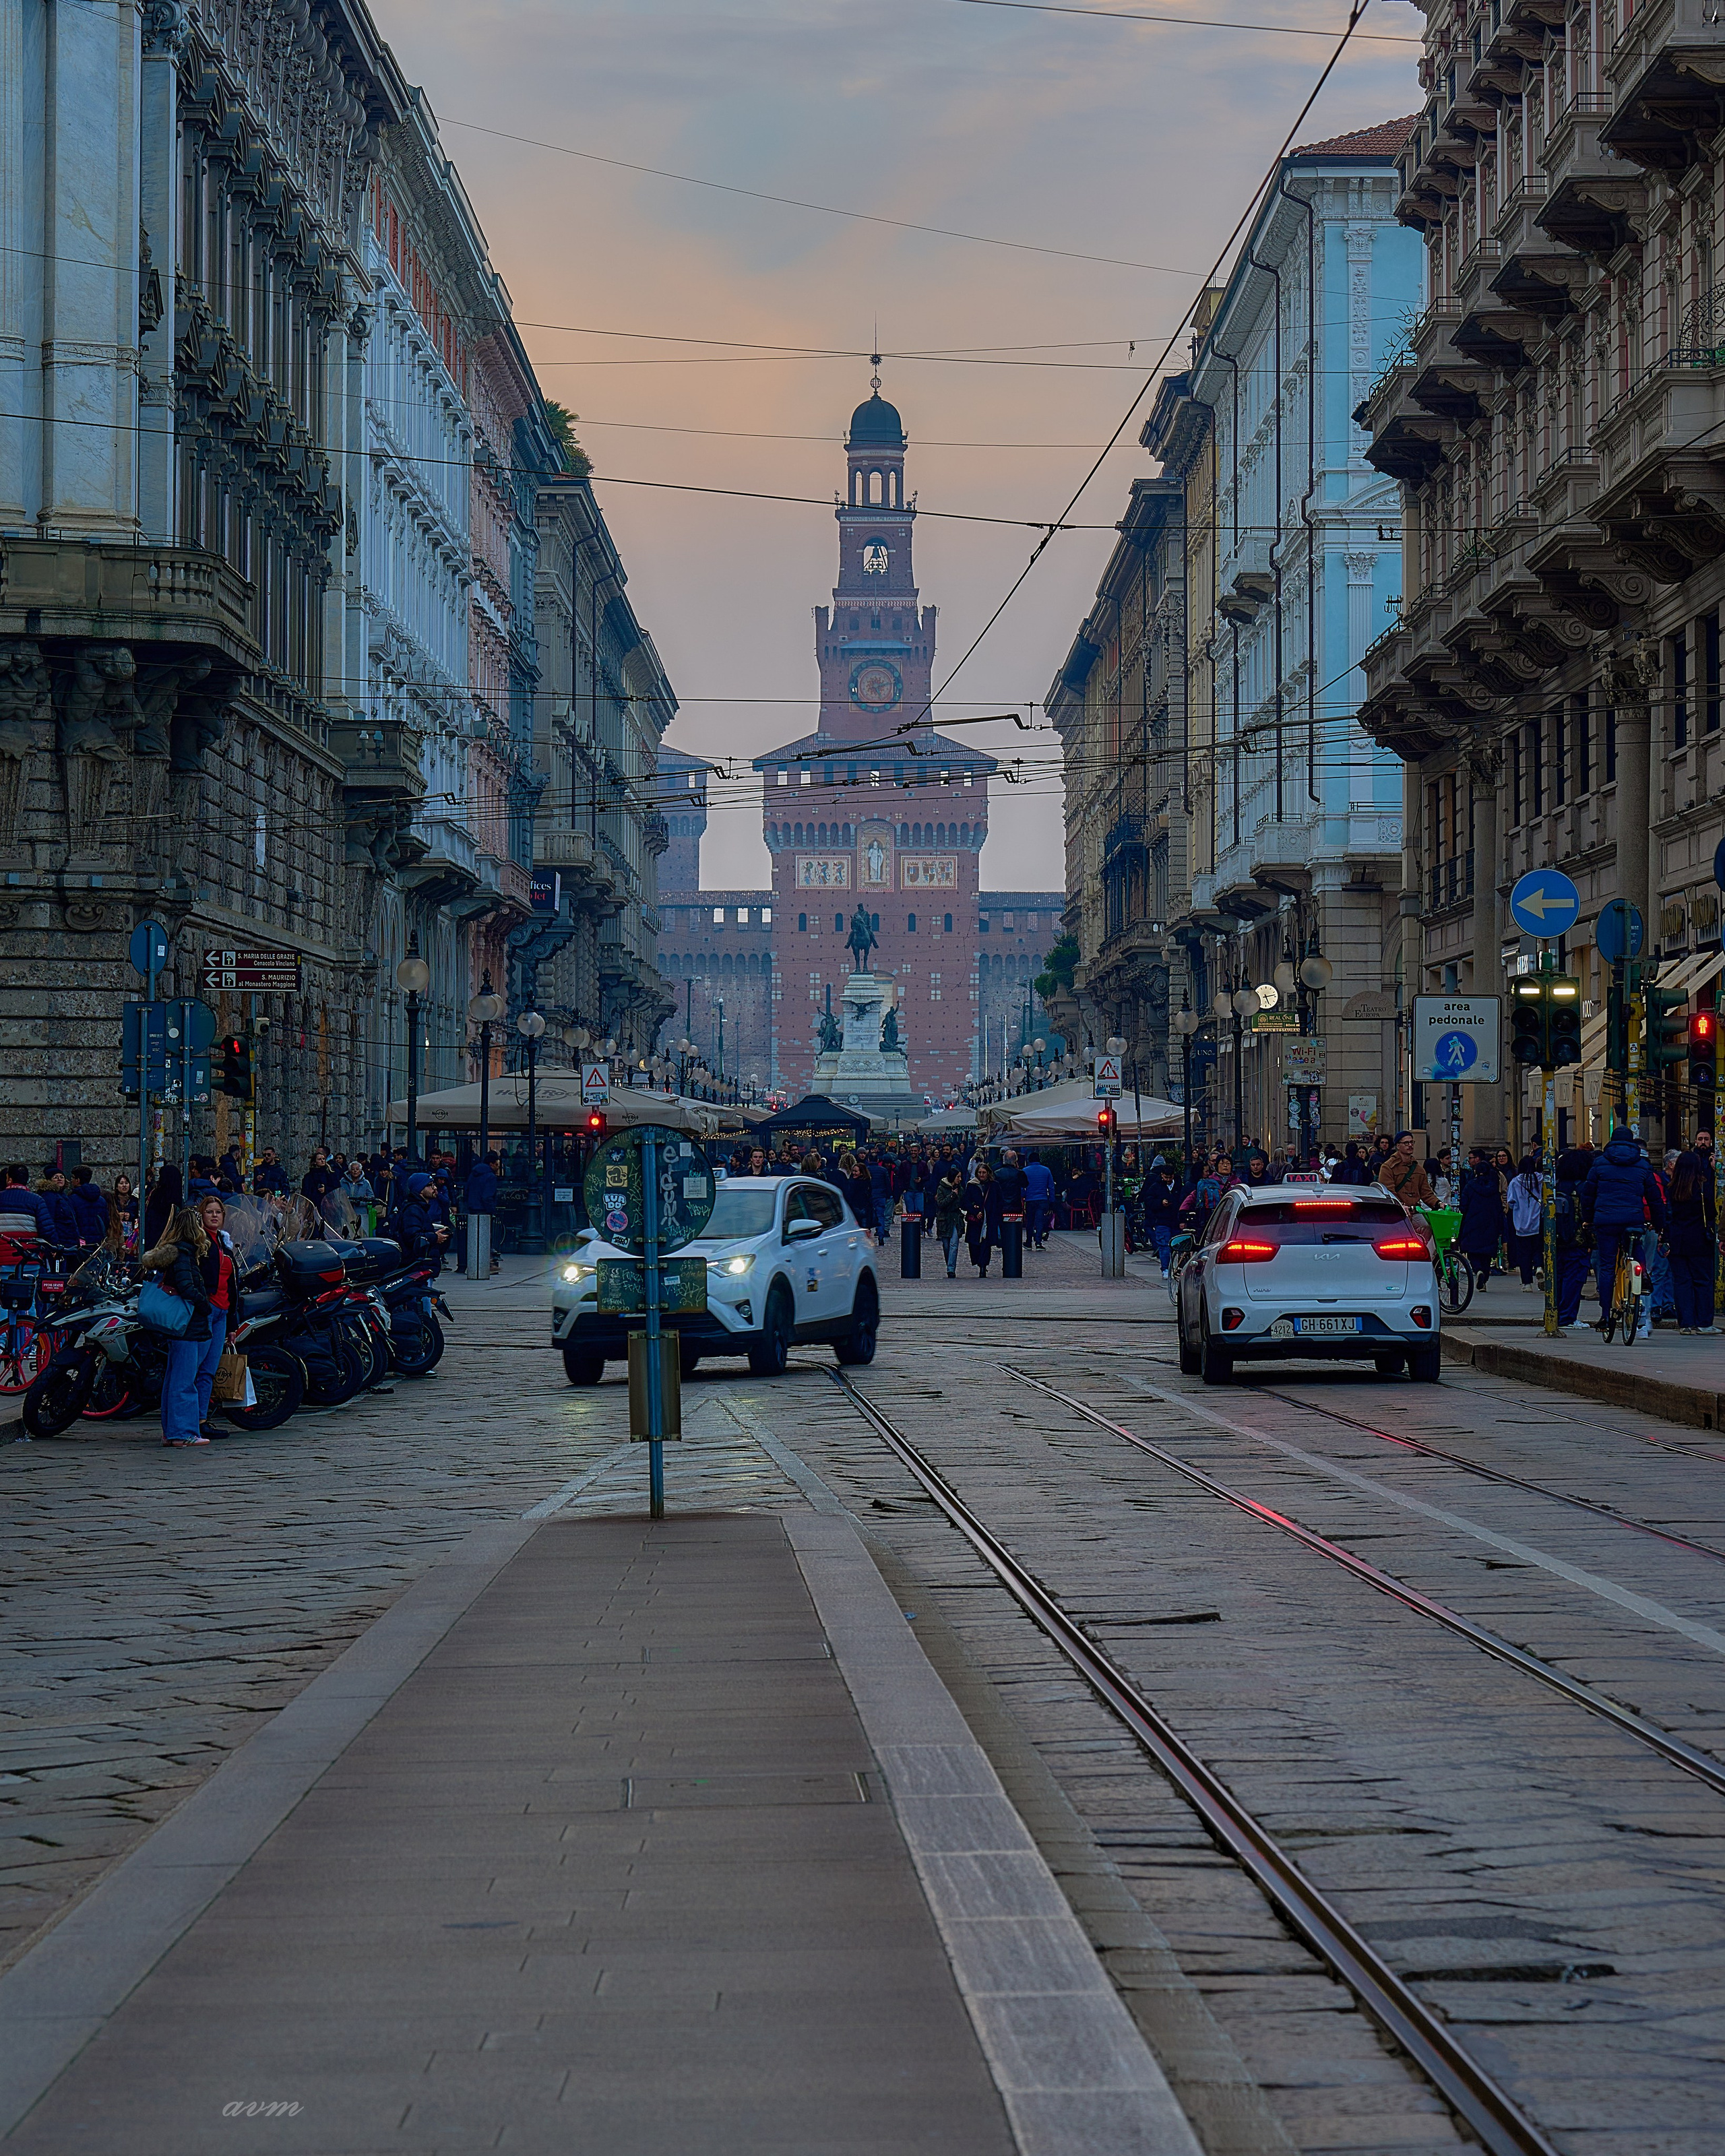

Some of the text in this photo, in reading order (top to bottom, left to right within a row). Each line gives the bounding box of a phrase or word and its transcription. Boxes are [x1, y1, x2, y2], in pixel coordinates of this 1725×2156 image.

[530, 881, 551, 890] fices
[1361, 1004, 1387, 1013] TEATRO
[1444, 1003, 1470, 1011] area
[1354, 1010, 1381, 1018] EUROPA
[1429, 1015, 1485, 1026] pedonale
[1292, 1047, 1316, 1055] Wi-Fi
[1274, 1325, 1291, 1334] 4212
